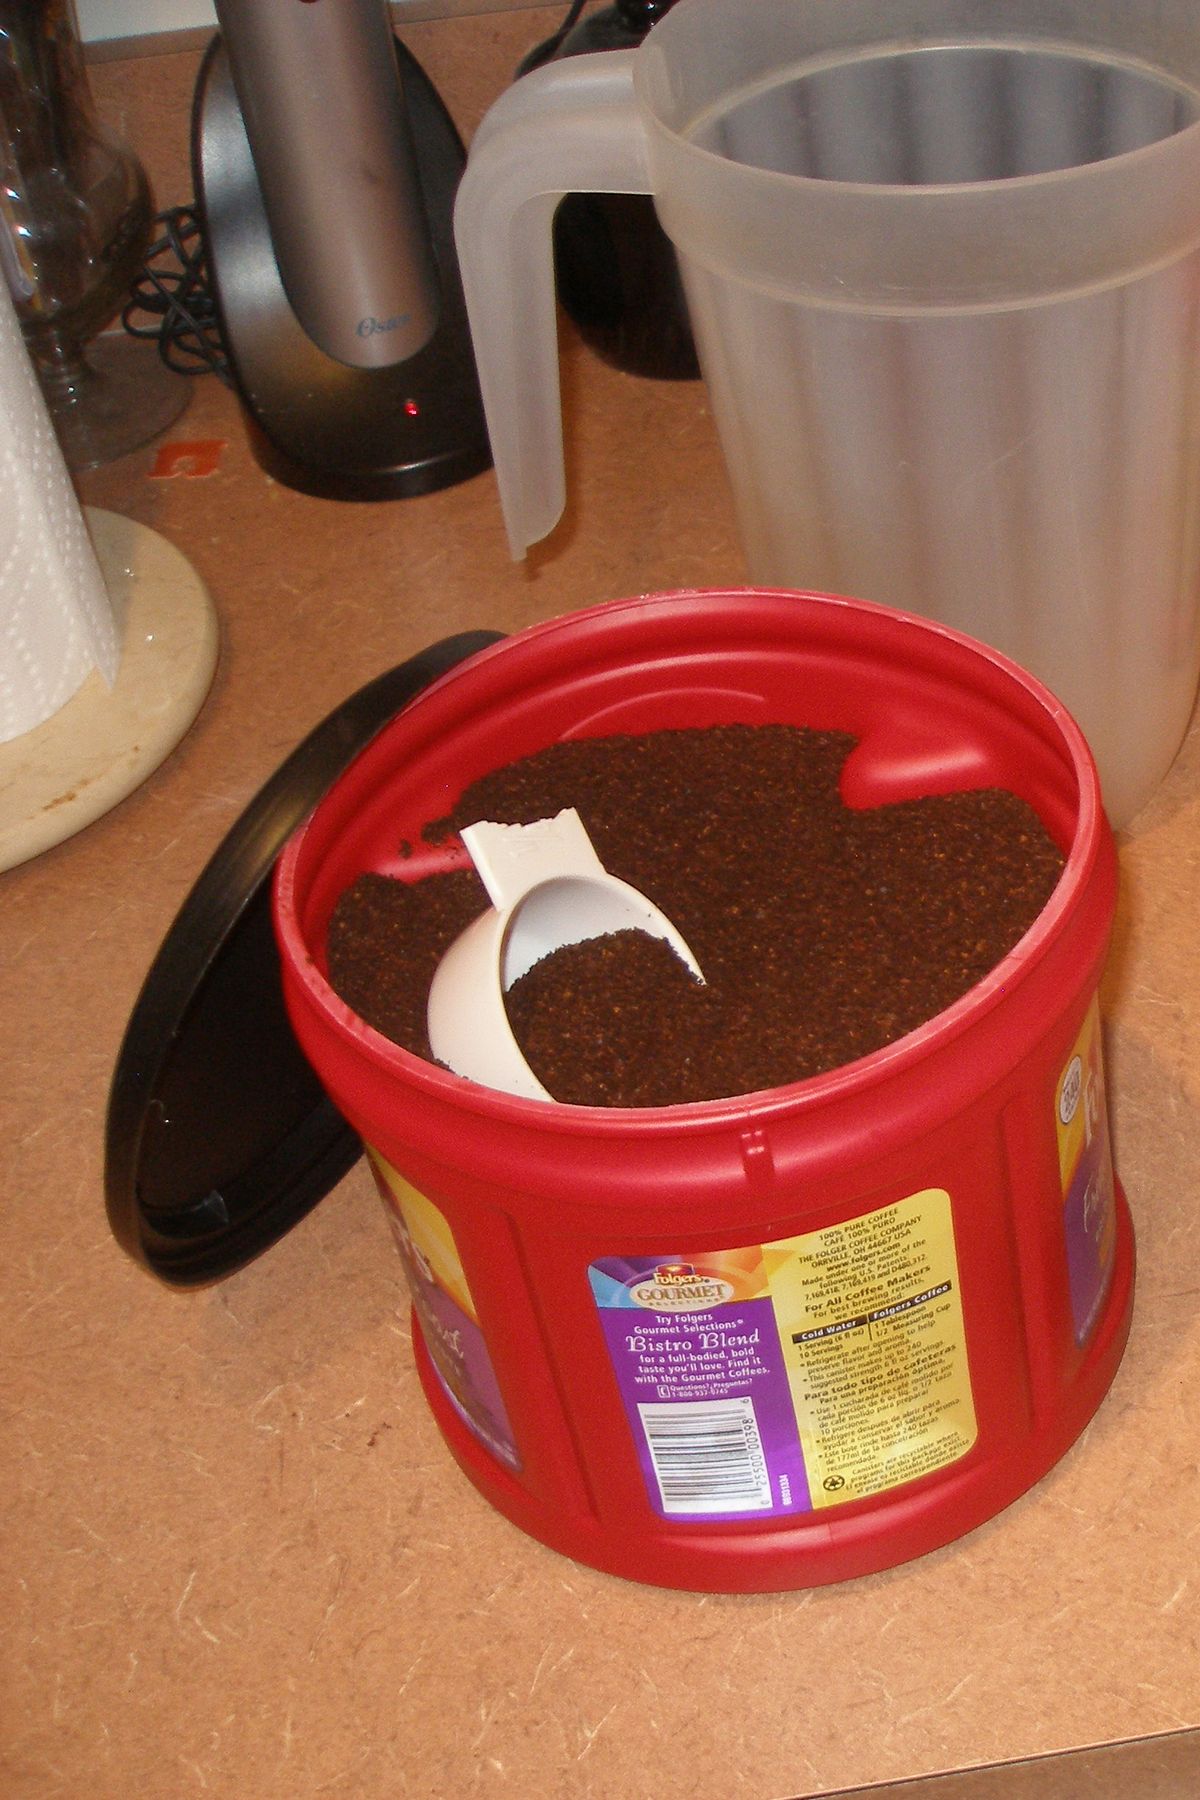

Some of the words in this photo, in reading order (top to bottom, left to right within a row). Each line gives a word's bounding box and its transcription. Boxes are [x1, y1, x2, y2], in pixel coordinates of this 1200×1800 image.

[819, 1230, 842, 1240] 100%
[844, 1222, 865, 1232] PURE
[868, 1208, 898, 1223] COFFEE
[848, 1228, 870, 1239] 100%
[873, 1218, 896, 1230] PURO
[799, 1255, 813, 1264] THE
[816, 1245, 847, 1258] FOLGER
[849, 1233, 878, 1250] COFFEE
[880, 1215, 922, 1236] COMPANY
[853, 1245, 866, 1254] OH
[867, 1235, 892, 1250] 44667
[894, 1229, 911, 1240] USA
[802, 1275, 822, 1286] Made
[826, 1268, 848, 1280] under
[851, 1264, 865, 1272] one
[867, 1260, 876, 1269] or
[879, 1252, 898, 1263] more
[902, 1244, 910, 1253] of
[913, 1238, 926, 1248] the
[827, 1242, 901, 1272] www.folgers.com
[654, 1273, 702, 1286] Folgers
[820, 1274, 857, 1289] following
[877, 1268, 891, 1279] and
[638, 1284, 726, 1301] GOURMET
[805, 1303, 823, 1312] For
[826, 1297, 841, 1307] All
[845, 1282, 884, 1300] Coffee
[887, 1266, 931, 1288] Makers
[813, 1309, 827, 1319] For
[830, 1304, 850, 1314] best
[852, 1290, 889, 1307] brewing
[873, 1302, 912, 1320] Folgers
[914, 1284, 949, 1303] Coffee
[656, 1315, 671, 1325] Try
[675, 1313, 713, 1324] Folgers
[834, 1312, 848, 1321] we
[881, 1305, 927, 1327] Tablespoon
[893, 1312, 934, 1330] Measuring
[936, 1303, 951, 1313] Cup
[625, 1335, 692, 1352] Bistro
[699, 1328, 760, 1350] Blend
[634, 1325, 680, 1334] Gourmet
[801, 1328, 824, 1340] Cold
[827, 1320, 857, 1334] Water
[639, 1354, 655, 1363] for
[668, 1350, 729, 1363] full-bodied,
[732, 1347, 755, 1356] bold
[800, 1351, 809, 1359] 10
[812, 1343, 843, 1357] Servings
[804, 1336, 833, 1350] Serving
[806, 1351, 848, 1367] Refrigerate
[852, 1344, 870, 1355] after
[873, 1333, 905, 1348] opening
[918, 1320, 936, 1332] help
[639, 1365, 665, 1373] taste
[668, 1363, 697, 1375] you'll
[700, 1359, 725, 1370] love.
[728, 1358, 750, 1367] Find
[753, 1356, 761, 1365] it
[804, 1389, 828, 1400] Para
[832, 1381, 857, 1394] todo
[861, 1373, 883, 1386] tipo
[887, 1367, 900, 1376] de
[904, 1344, 957, 1370] cafeteras
[808, 1362, 840, 1375] preserve
[842, 1355, 865, 1368] flavor
[868, 1348, 882, 1358] and
[809, 1374, 824, 1382] This
[827, 1366, 856, 1378] canister
[858, 1358, 882, 1369] makes
[907, 1341, 921, 1351] 240
[811, 1374, 848, 1389] suggested
[850, 1366, 883, 1380] strength
[911, 1340, 944, 1358] servings
[635, 1374, 657, 1384] with
[661, 1372, 677, 1382] the
[681, 1370, 725, 1382] Gourmet
[729, 1365, 770, 1378] Coffees.
[670, 1381, 709, 1391] Questions?
[816, 1406, 831, 1415] Use
[840, 1392, 879, 1408] cucharada
[881, 1387, 890, 1395] de
[893, 1381, 909, 1392] café
[912, 1368, 939, 1384] molido
[941, 1363, 954, 1374] por
[818, 1412, 836, 1421] cada
[868, 1399, 878, 1407] de
[935, 1372, 952, 1382] taza
[820, 1396, 838, 1404] Para
[859, 1372, 910, 1395] preparación
[742, 1418, 759, 1449] 00398
